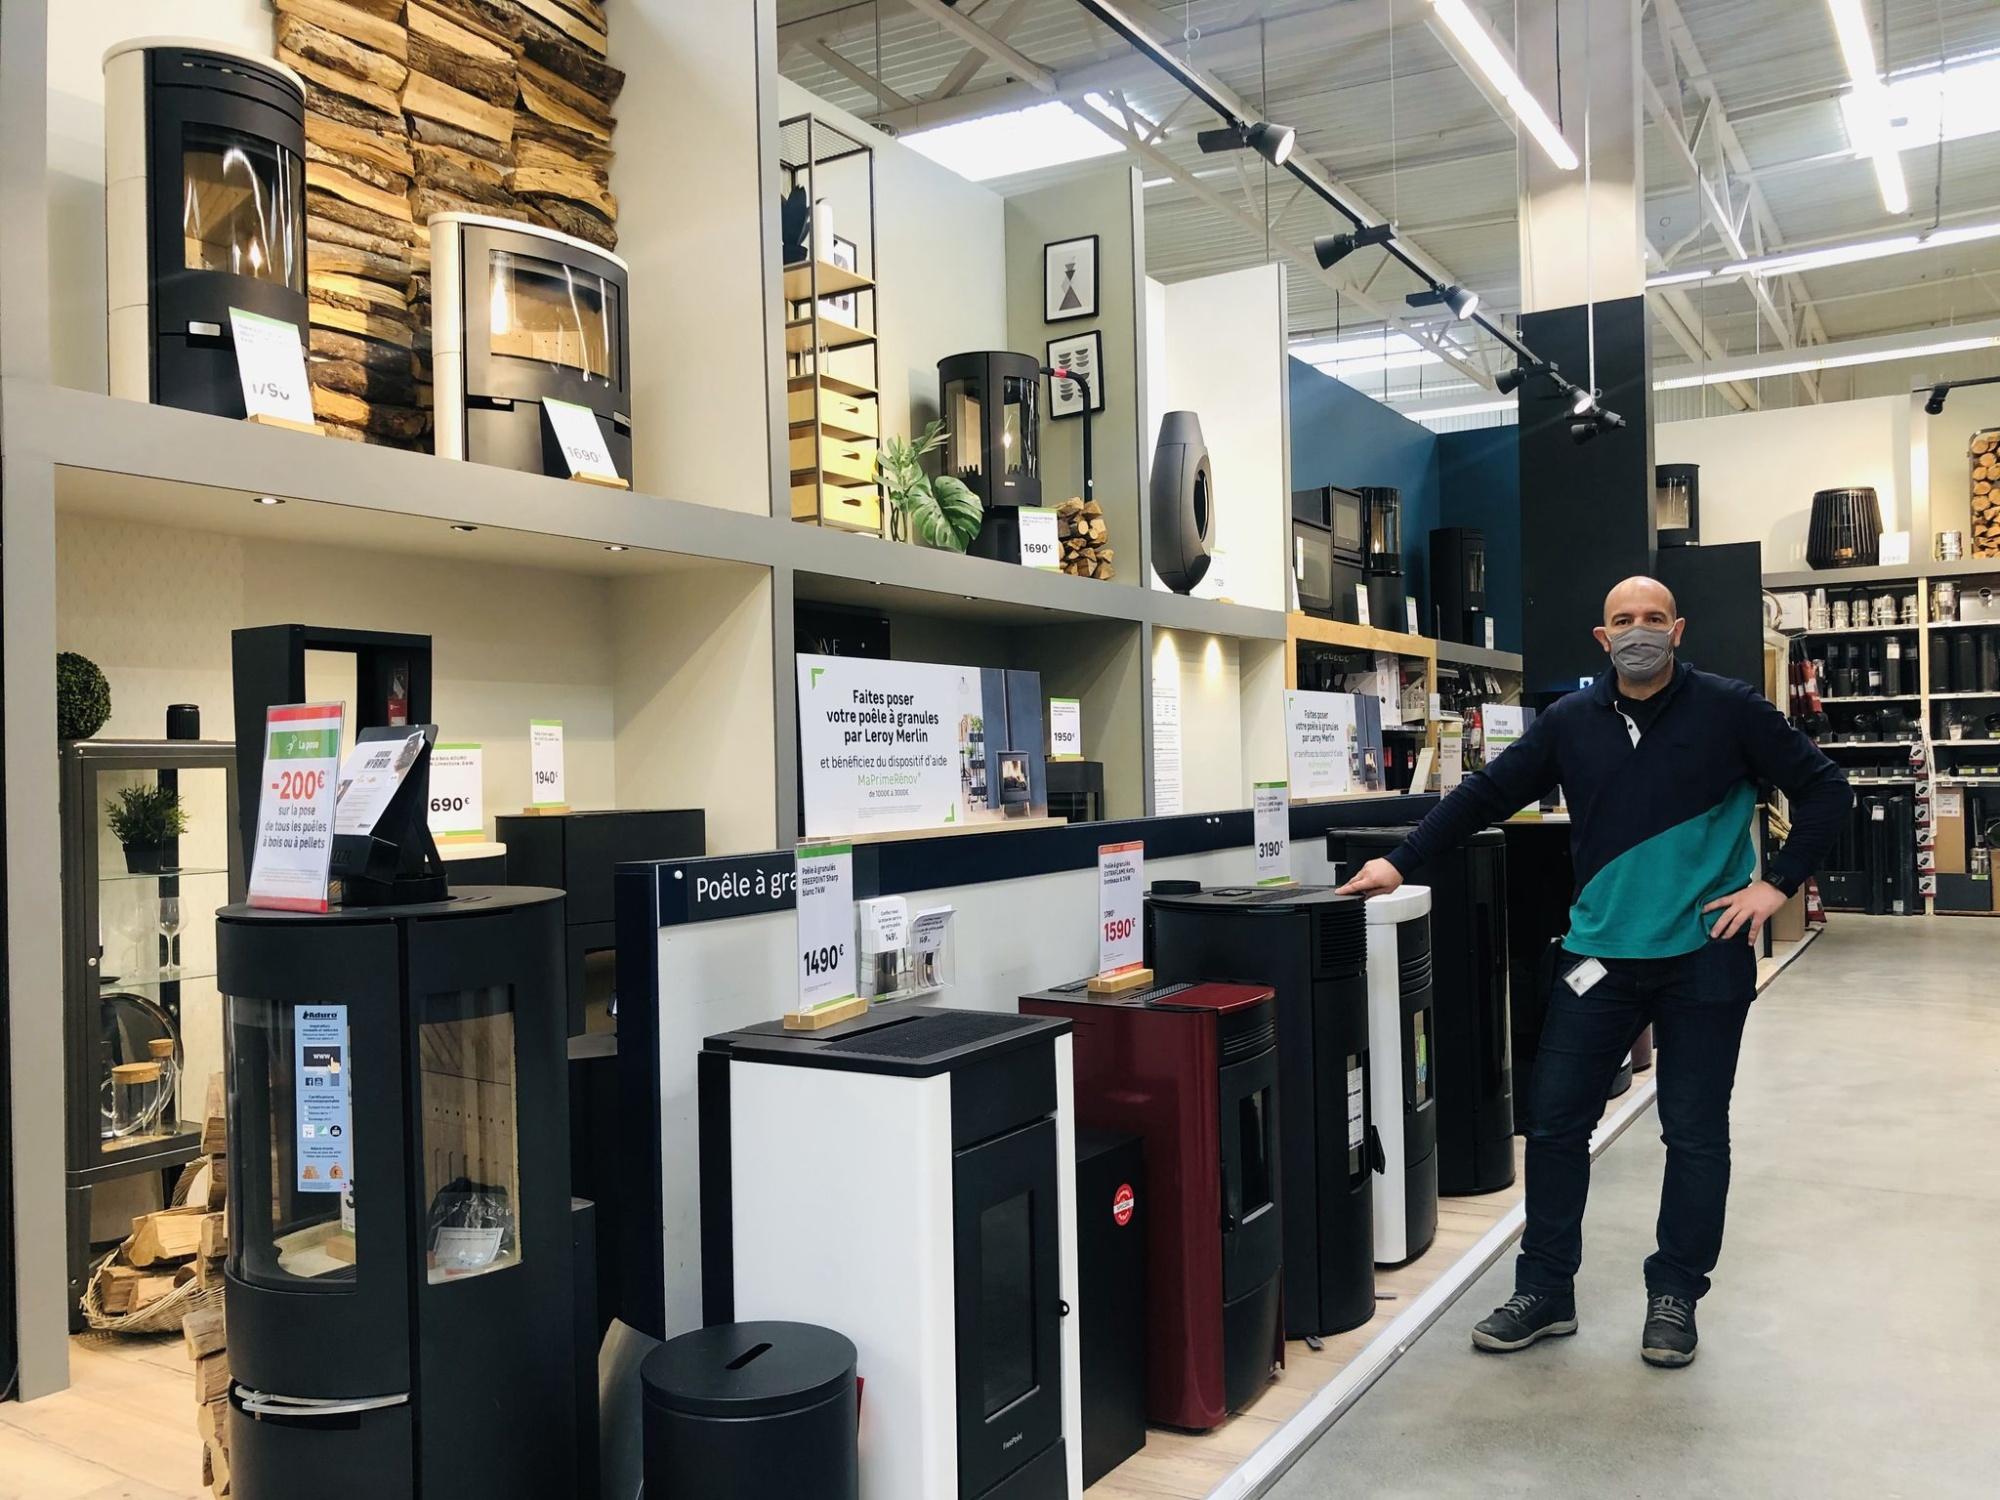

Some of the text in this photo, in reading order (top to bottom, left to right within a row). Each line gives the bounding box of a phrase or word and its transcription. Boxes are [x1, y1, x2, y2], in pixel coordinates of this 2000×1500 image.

[853, 690, 914, 708] Faites poser
[827, 708, 939, 727] votre poêle à granules
[844, 729, 928, 745] par Leroy Merlin
[820, 755, 948, 771] et bénéficiez du dispositif d'aide
[272, 770, 325, 800] -200€
[278, 804, 316, 819] sur la pose
[265, 820, 327, 834] de tous les poêles
[263, 835, 325, 850] à bois ou à pellets
[802, 865, 814, 875] Poêle
[697, 871, 750, 902] Poêle
[755, 869, 765, 894] à
[1104, 917, 1136, 942] 1590€
[804, 944, 844, 977] 1490€
